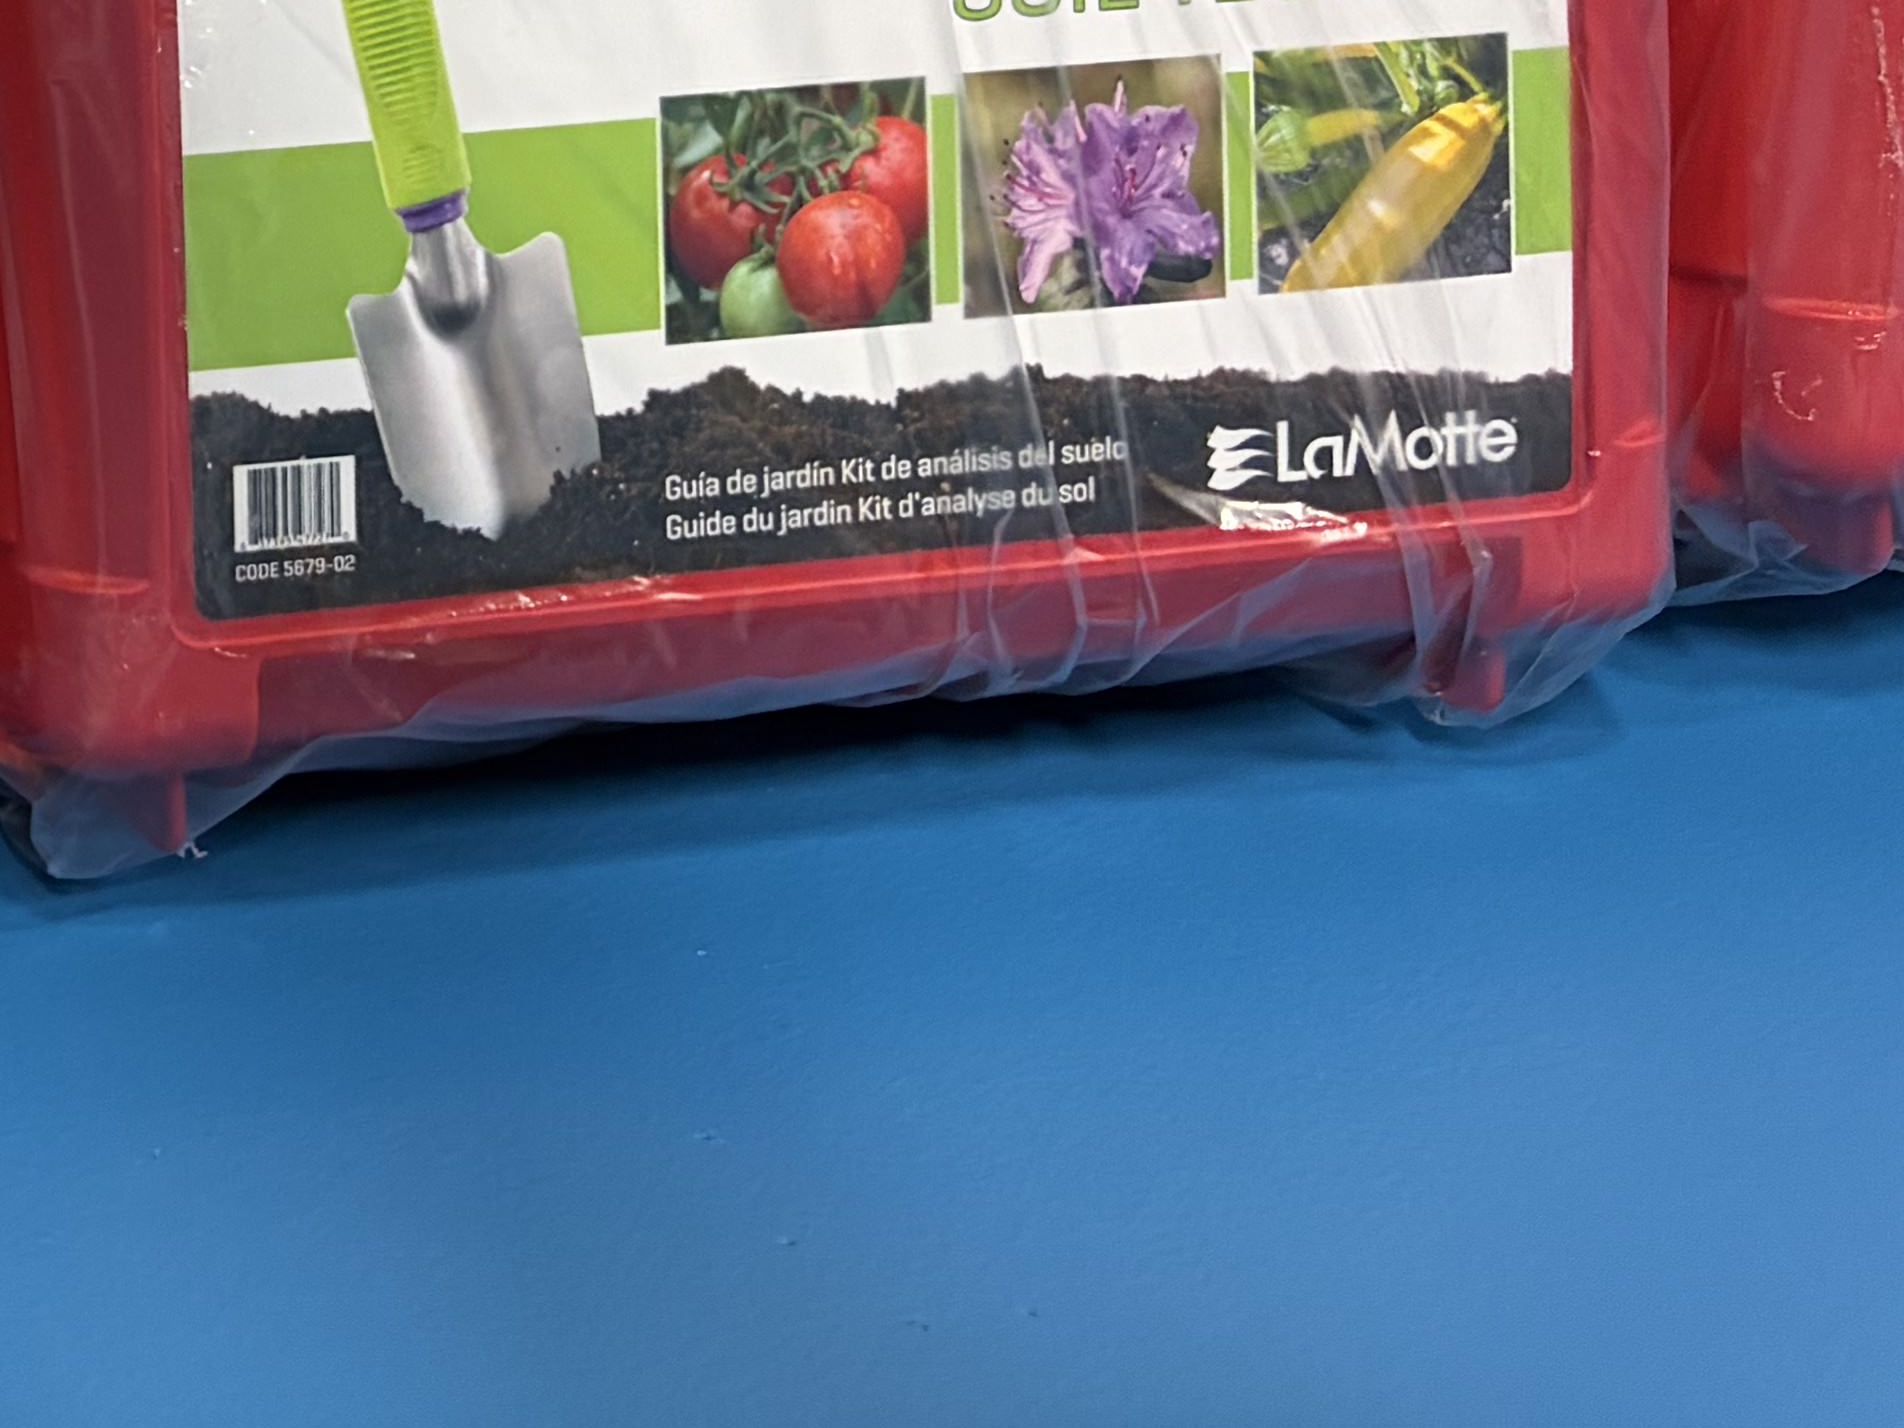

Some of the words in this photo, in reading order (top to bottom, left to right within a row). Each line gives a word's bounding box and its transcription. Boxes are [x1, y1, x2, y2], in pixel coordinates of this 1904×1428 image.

[665, 474, 720, 501] Guía
[726, 470, 756, 495] de
[762, 462, 834, 497] jardín
[841, 458, 875, 484] Kit
[881, 454, 911, 479] de
[917, 447, 1012, 476] análisis
[1018, 441, 1054, 468] del
[1277, 410, 1517, 482] LaMotte
[666, 513, 736, 541] Guide
[742, 507, 773, 533] du
[779, 501, 851, 536] jardin
[858, 496, 892, 522] Kit
[898, 487, 1015, 520] d'analyse
[1022, 481, 1052, 506] du
[1059, 476, 1095, 503] sol
[235, 562, 279, 582] CODE
[284, 554, 355, 577] 5679-02
